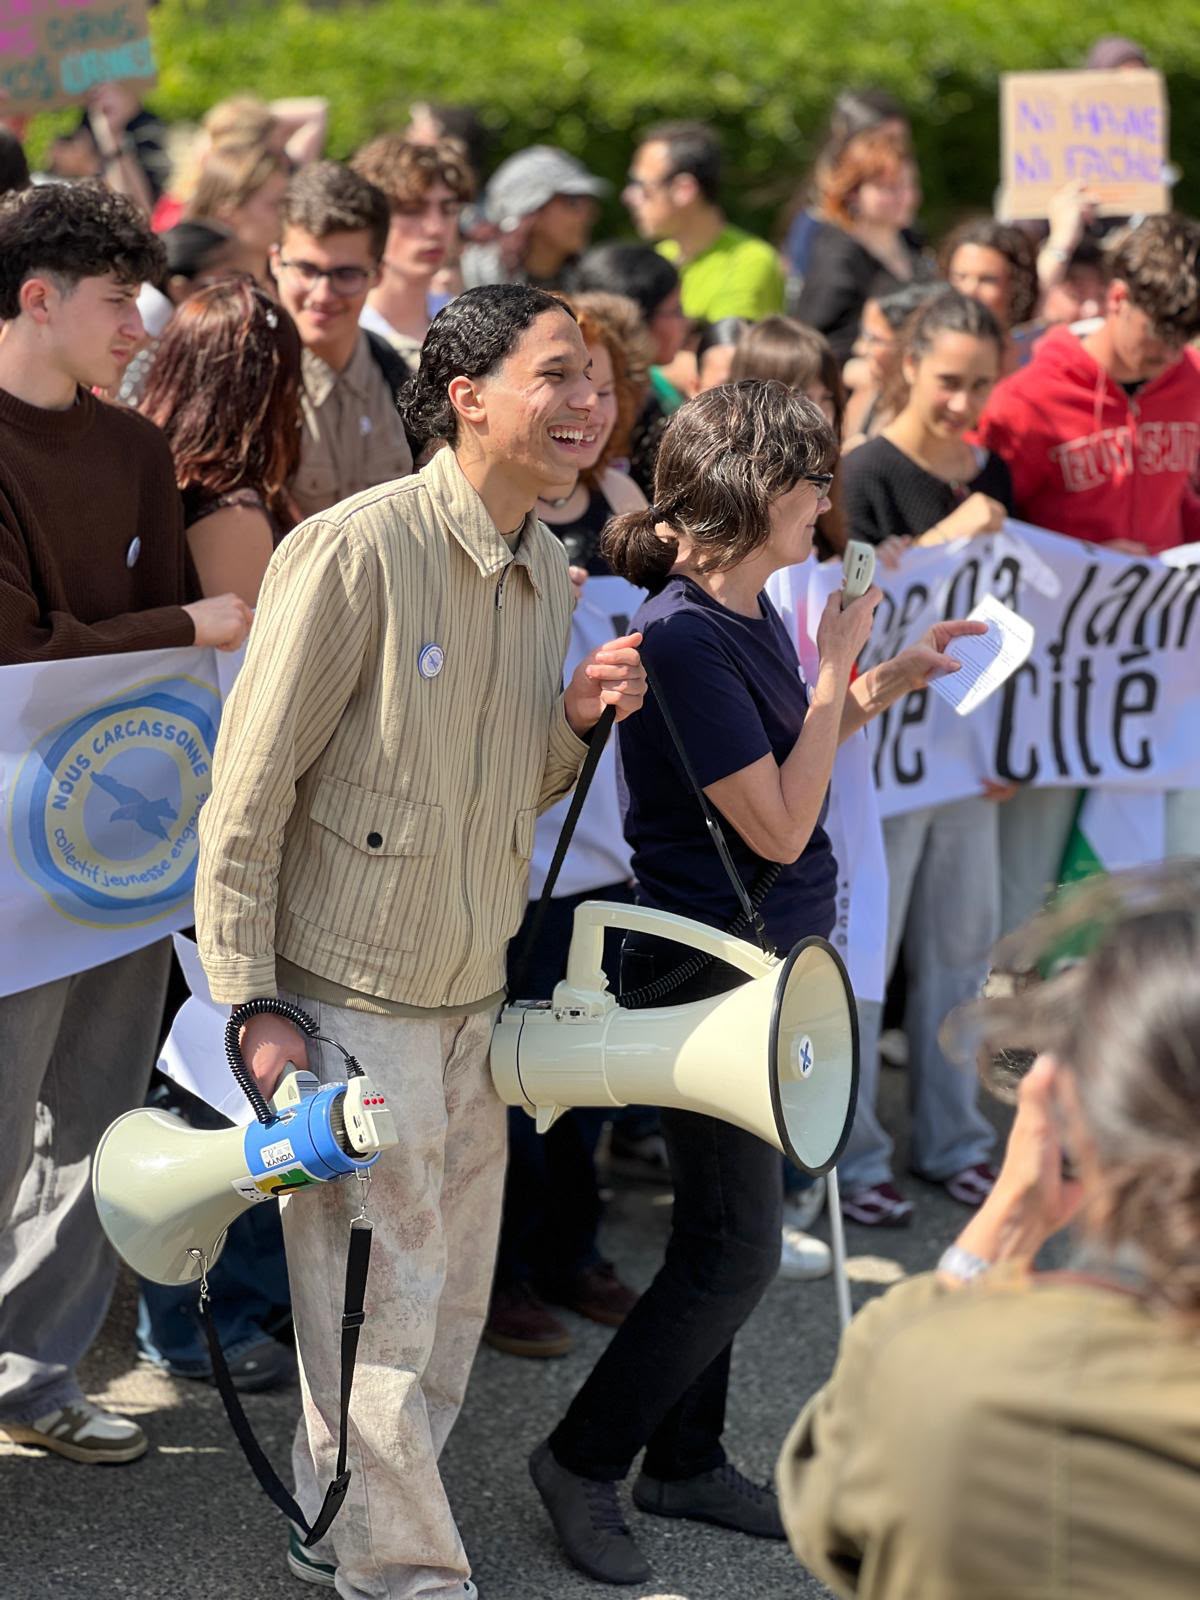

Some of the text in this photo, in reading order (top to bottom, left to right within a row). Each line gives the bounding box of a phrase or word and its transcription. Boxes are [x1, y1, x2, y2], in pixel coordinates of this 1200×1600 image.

[52, 719, 209, 811] NOUS CARCASSONNE
[102, 858, 172, 888] jeunesse
[265, 1152, 294, 1168] VONYX
